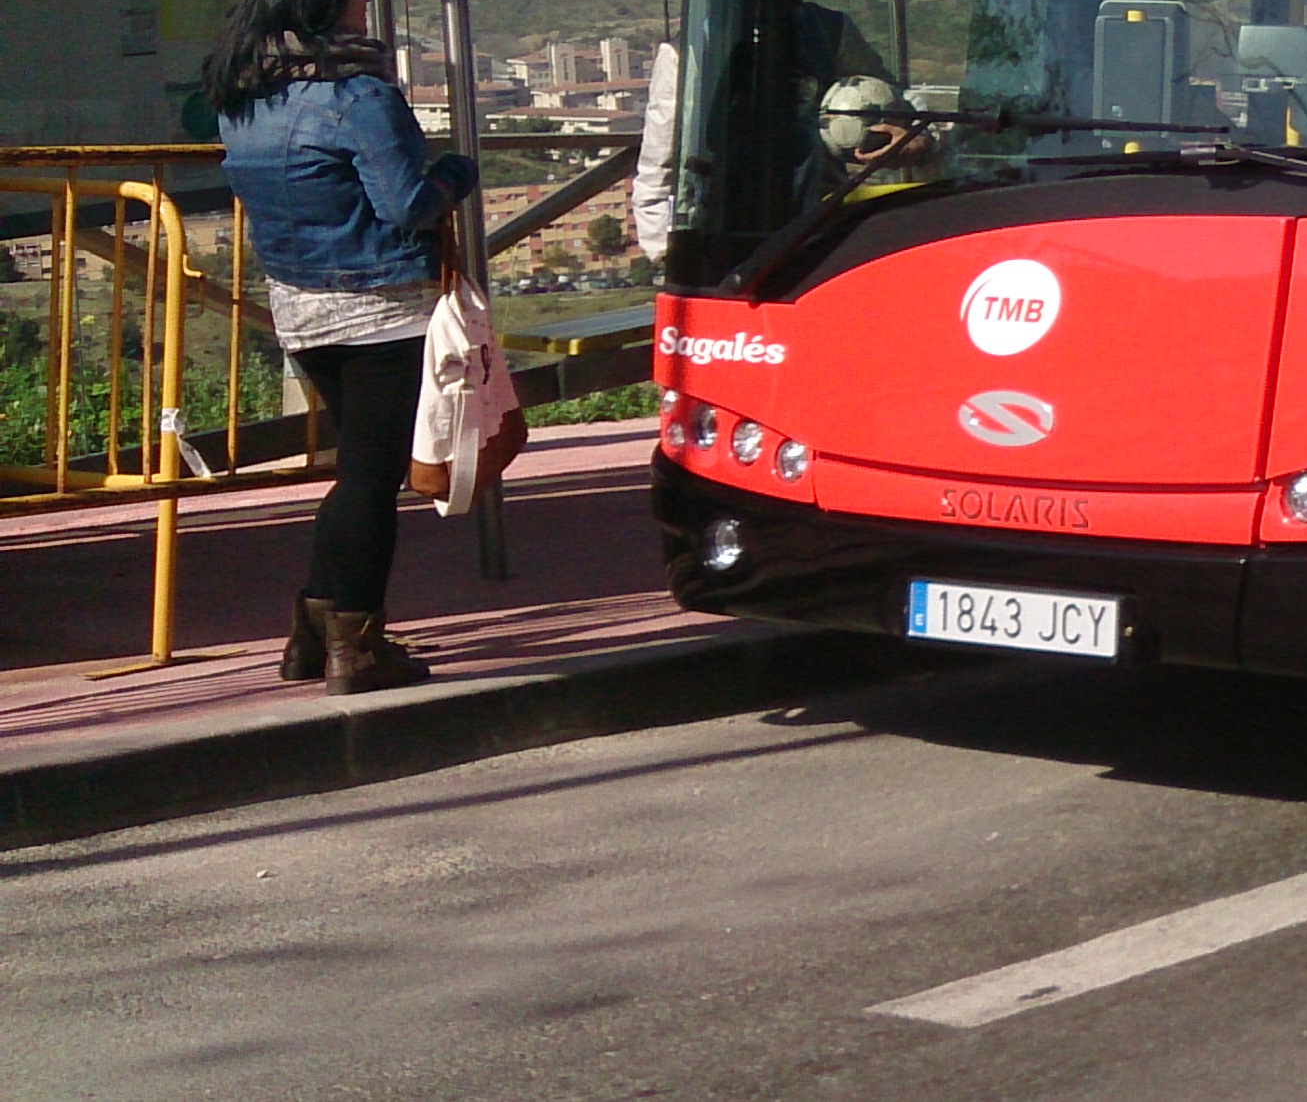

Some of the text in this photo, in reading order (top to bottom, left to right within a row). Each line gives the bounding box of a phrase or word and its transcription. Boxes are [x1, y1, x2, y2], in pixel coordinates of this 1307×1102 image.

[983, 296, 1045, 323] TMB
[659, 326, 785, 365] Sagalés
[940, 488, 1090, 528] SOLARIS
[938, 591, 1022, 639] 1843
[1038, 601, 1107, 647] JCY
